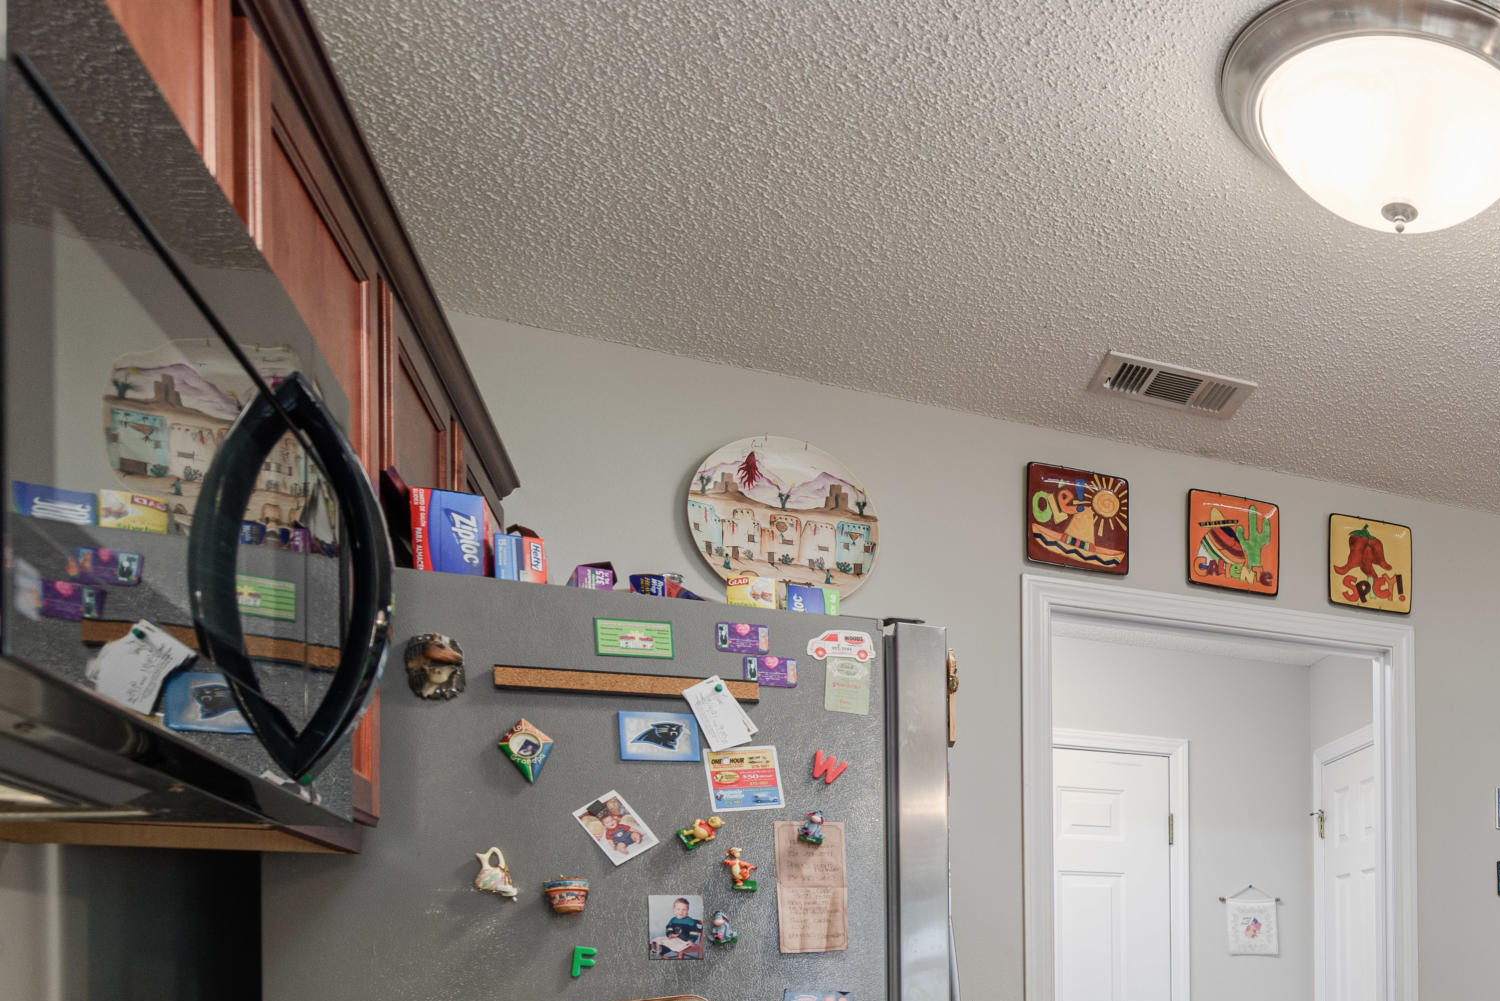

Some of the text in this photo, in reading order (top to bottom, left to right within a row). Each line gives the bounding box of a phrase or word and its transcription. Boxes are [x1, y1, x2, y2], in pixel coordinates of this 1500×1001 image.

[450, 512, 481, 565] Ziploc
[531, 544, 541, 570] Hefty
[728, 577, 749, 586] GLAD
[812, 749, 848, 784] W
[571, 945, 597, 977] F
